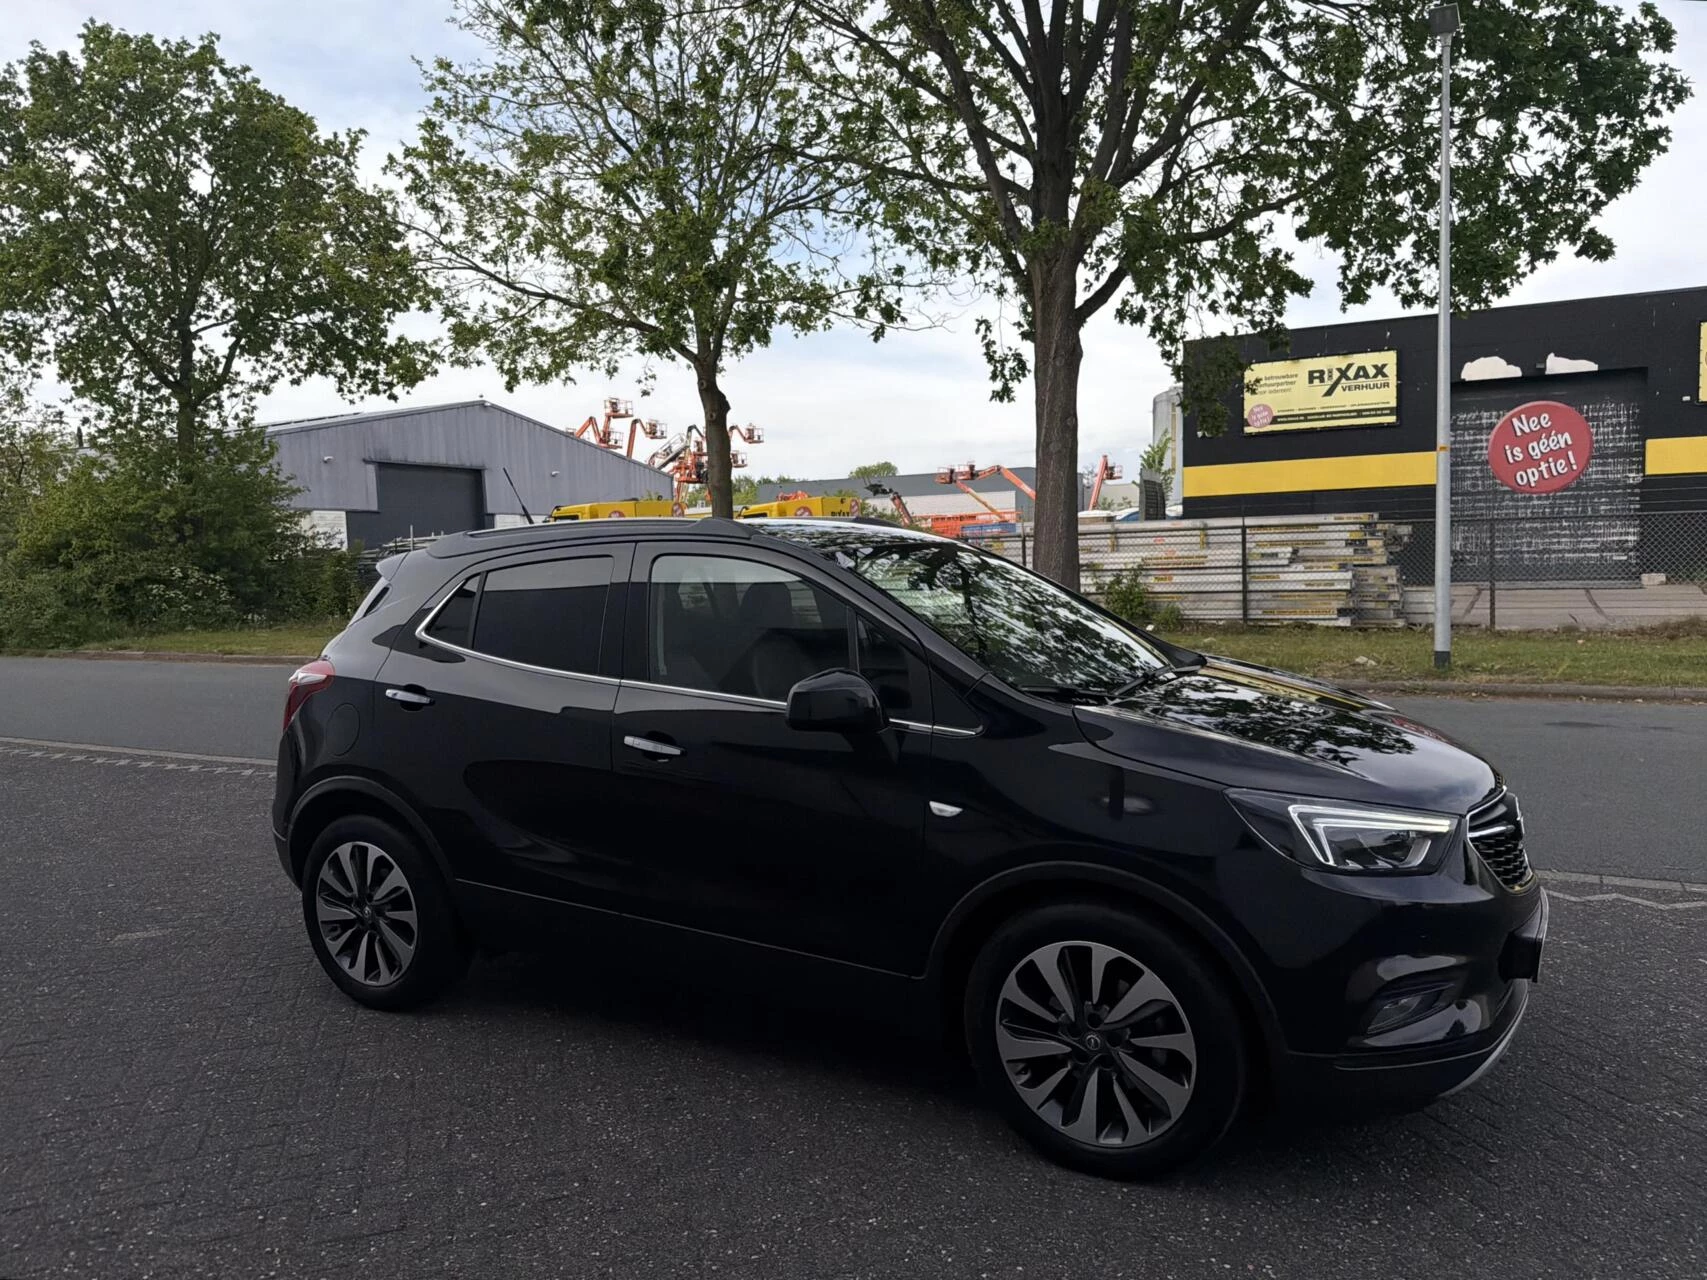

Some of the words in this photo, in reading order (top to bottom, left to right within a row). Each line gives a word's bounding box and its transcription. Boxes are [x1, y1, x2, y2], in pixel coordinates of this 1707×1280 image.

[1308, 362, 1389, 397] RIXAX
[1341, 381, 1390, 392] VERHUUR
[1511, 412, 1552, 437] Nee
[1504, 444, 1524, 464] is
[1527, 430, 1573, 460] géén
[1515, 451, 1578, 487] optie!
